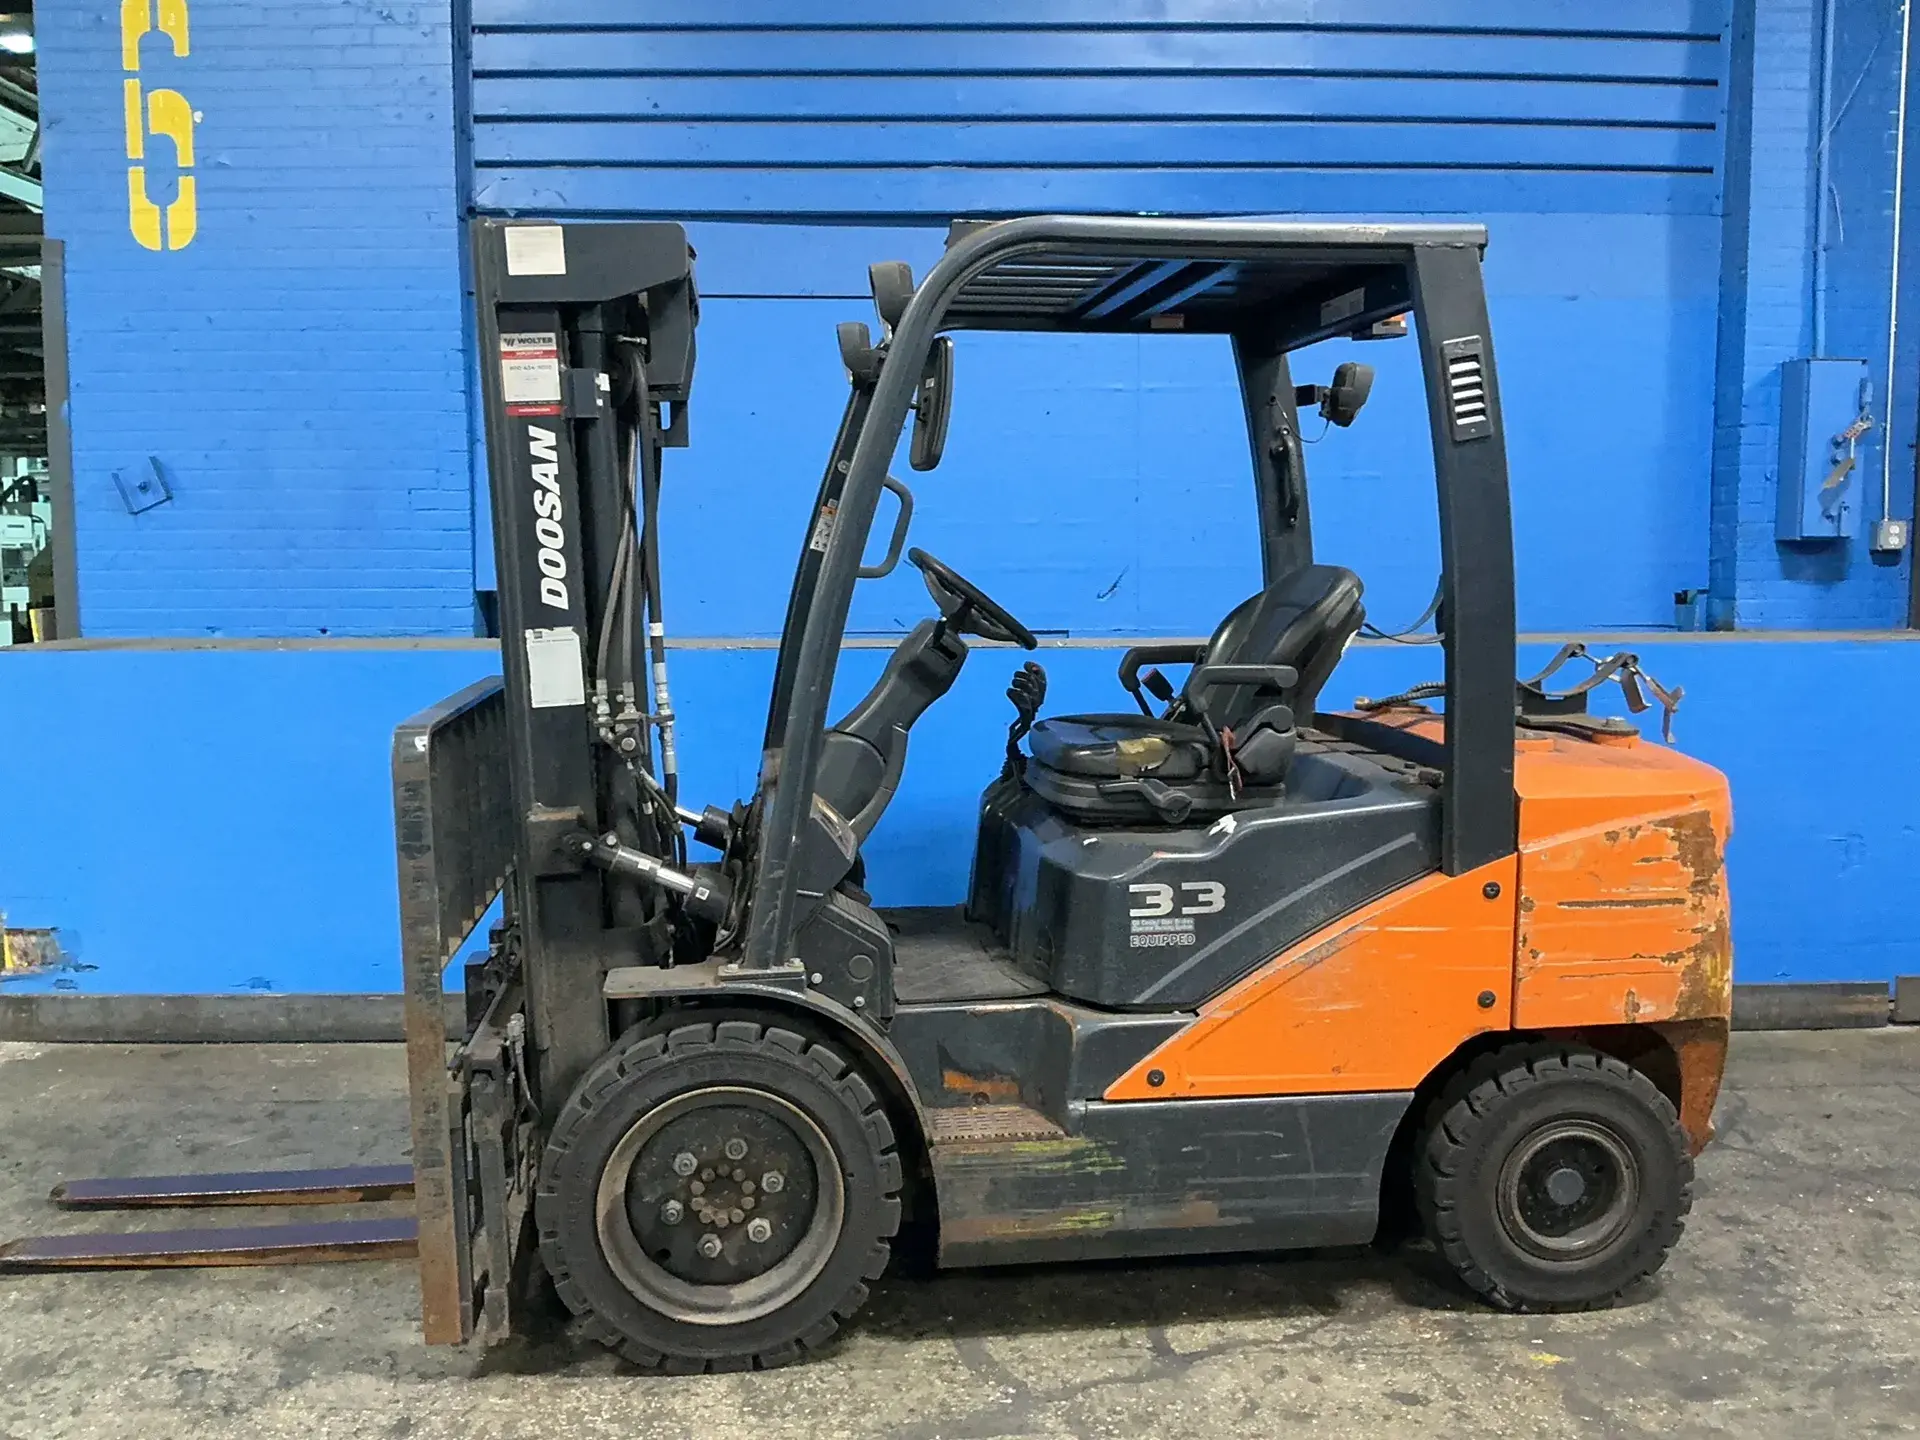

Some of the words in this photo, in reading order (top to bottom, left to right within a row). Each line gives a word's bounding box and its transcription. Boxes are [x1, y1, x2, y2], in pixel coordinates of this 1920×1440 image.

[121, 0, 197, 251] 6
[517, 336, 553, 345] WOLTER
[528, 425, 569, 610] DOOSAN
[1129, 881, 1226, 917] 33
[1130, 933, 1196, 948] EQUIPPED
